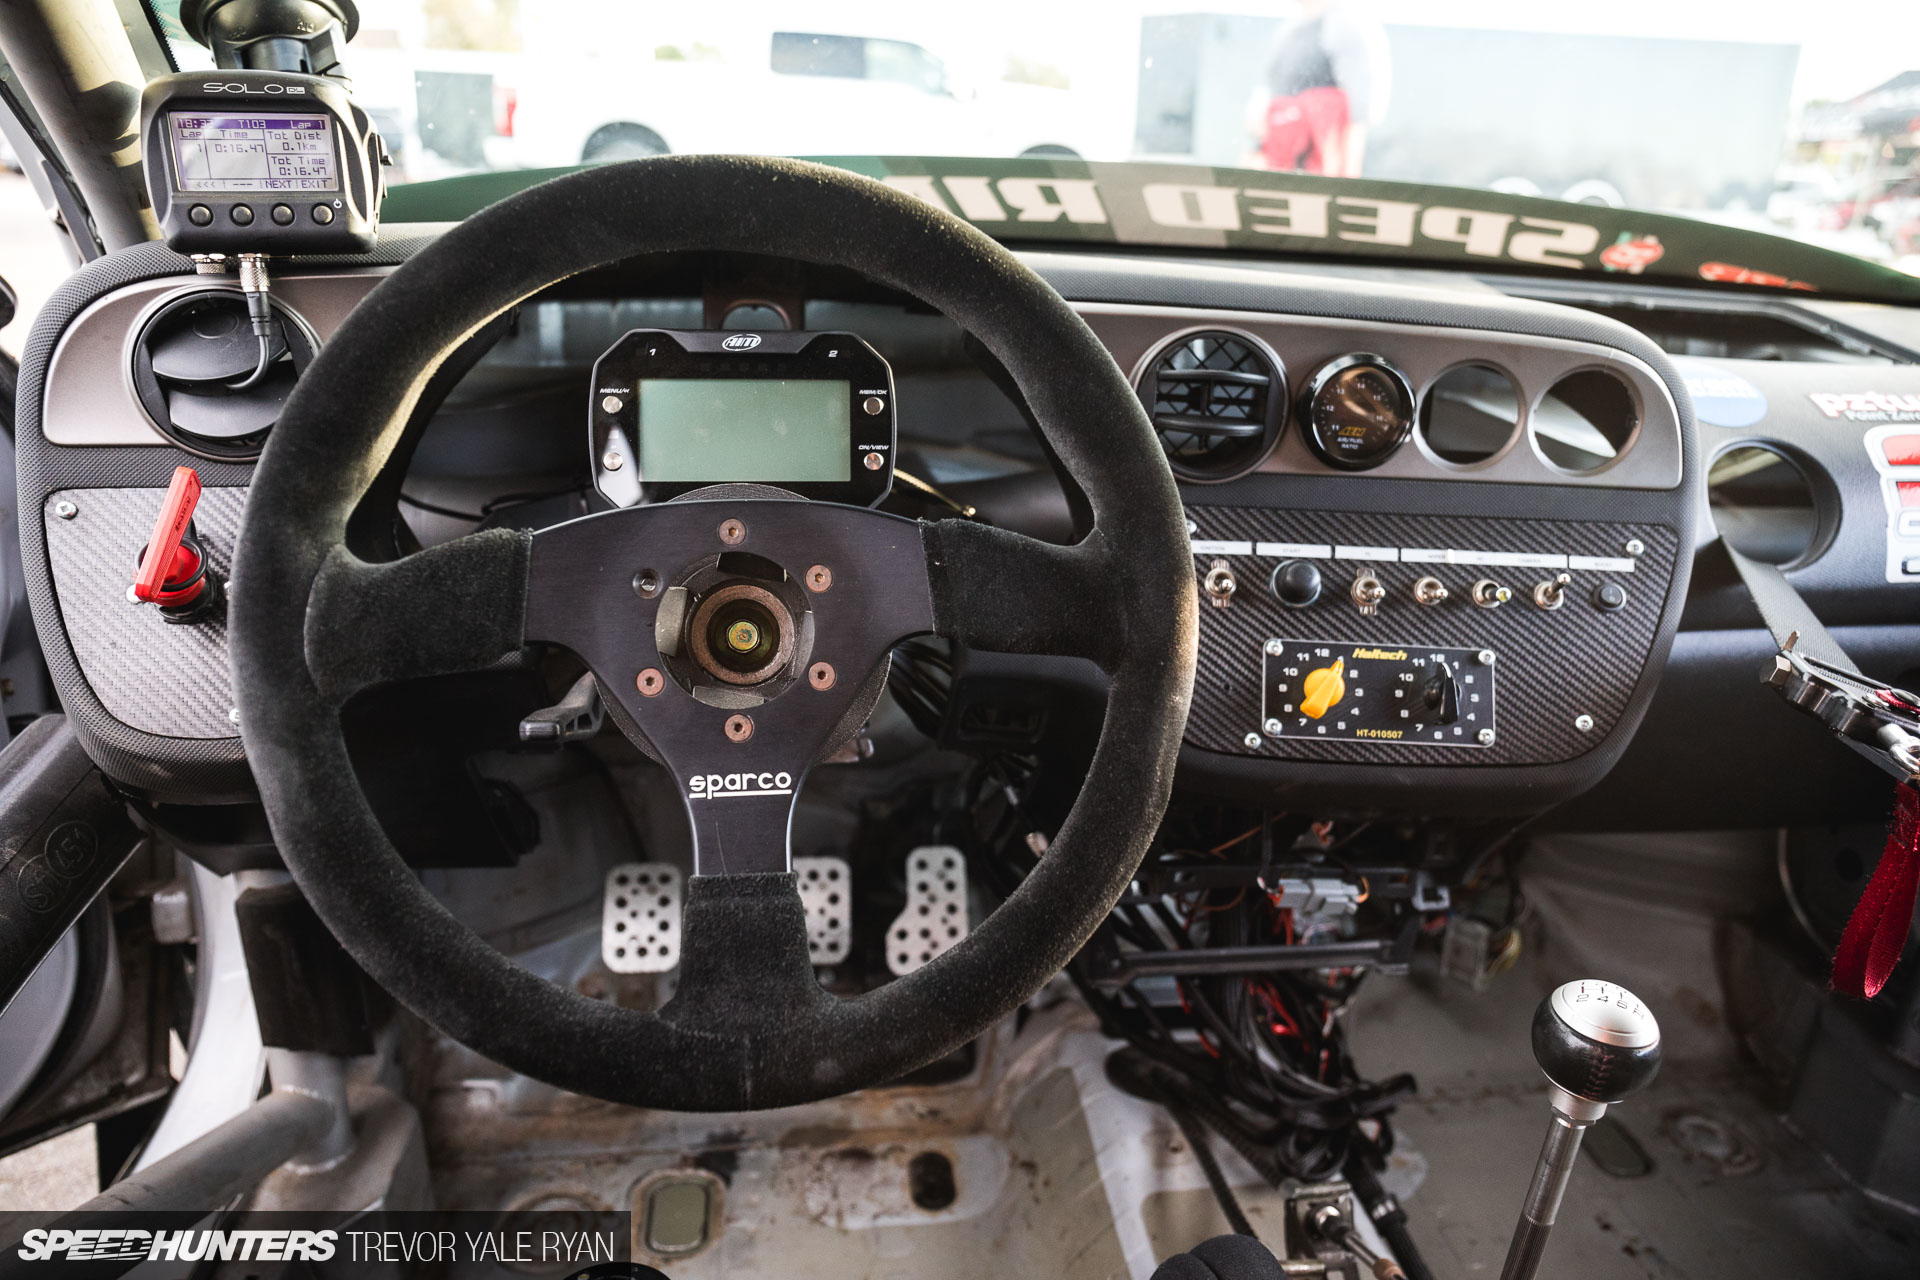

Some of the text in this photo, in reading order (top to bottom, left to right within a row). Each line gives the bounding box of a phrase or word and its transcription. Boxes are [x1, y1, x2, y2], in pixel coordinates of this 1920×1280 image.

[203, 82, 284, 94] SOLO
[238, 119, 266, 129] T103
[290, 120, 311, 129] Lap
[220, 129, 248, 138] Time
[267, 131, 322, 140] Tot Dist
[215, 143, 264, 153] 0:16.47
[271, 156, 326, 165] Tot Time
[279, 167, 327, 176] 0:16.47
[265, 180, 292, 189] NEXT
[301, 180, 328, 188] EXIT
[828, 350, 838, 358] 2
[1297, 653, 1310, 661] 11
[1314, 648, 1330, 657] 12
[1352, 648, 1408, 661] Haltech
[1412, 658, 1425, 667] 11
[1452, 661, 1459, 670] 1
[1283, 667, 1298, 676] 10
[1398, 673, 1414, 682] 10
[1354, 688, 1364, 697] 3
[1350, 707, 1360, 716] 4
[1466, 713, 1476, 721] 4
[1298, 718, 1307, 726] 7
[1415, 723, 1424, 732] 7
[1356, 729, 1403, 739] HT-010507
[688, 772, 793, 799] sparco
